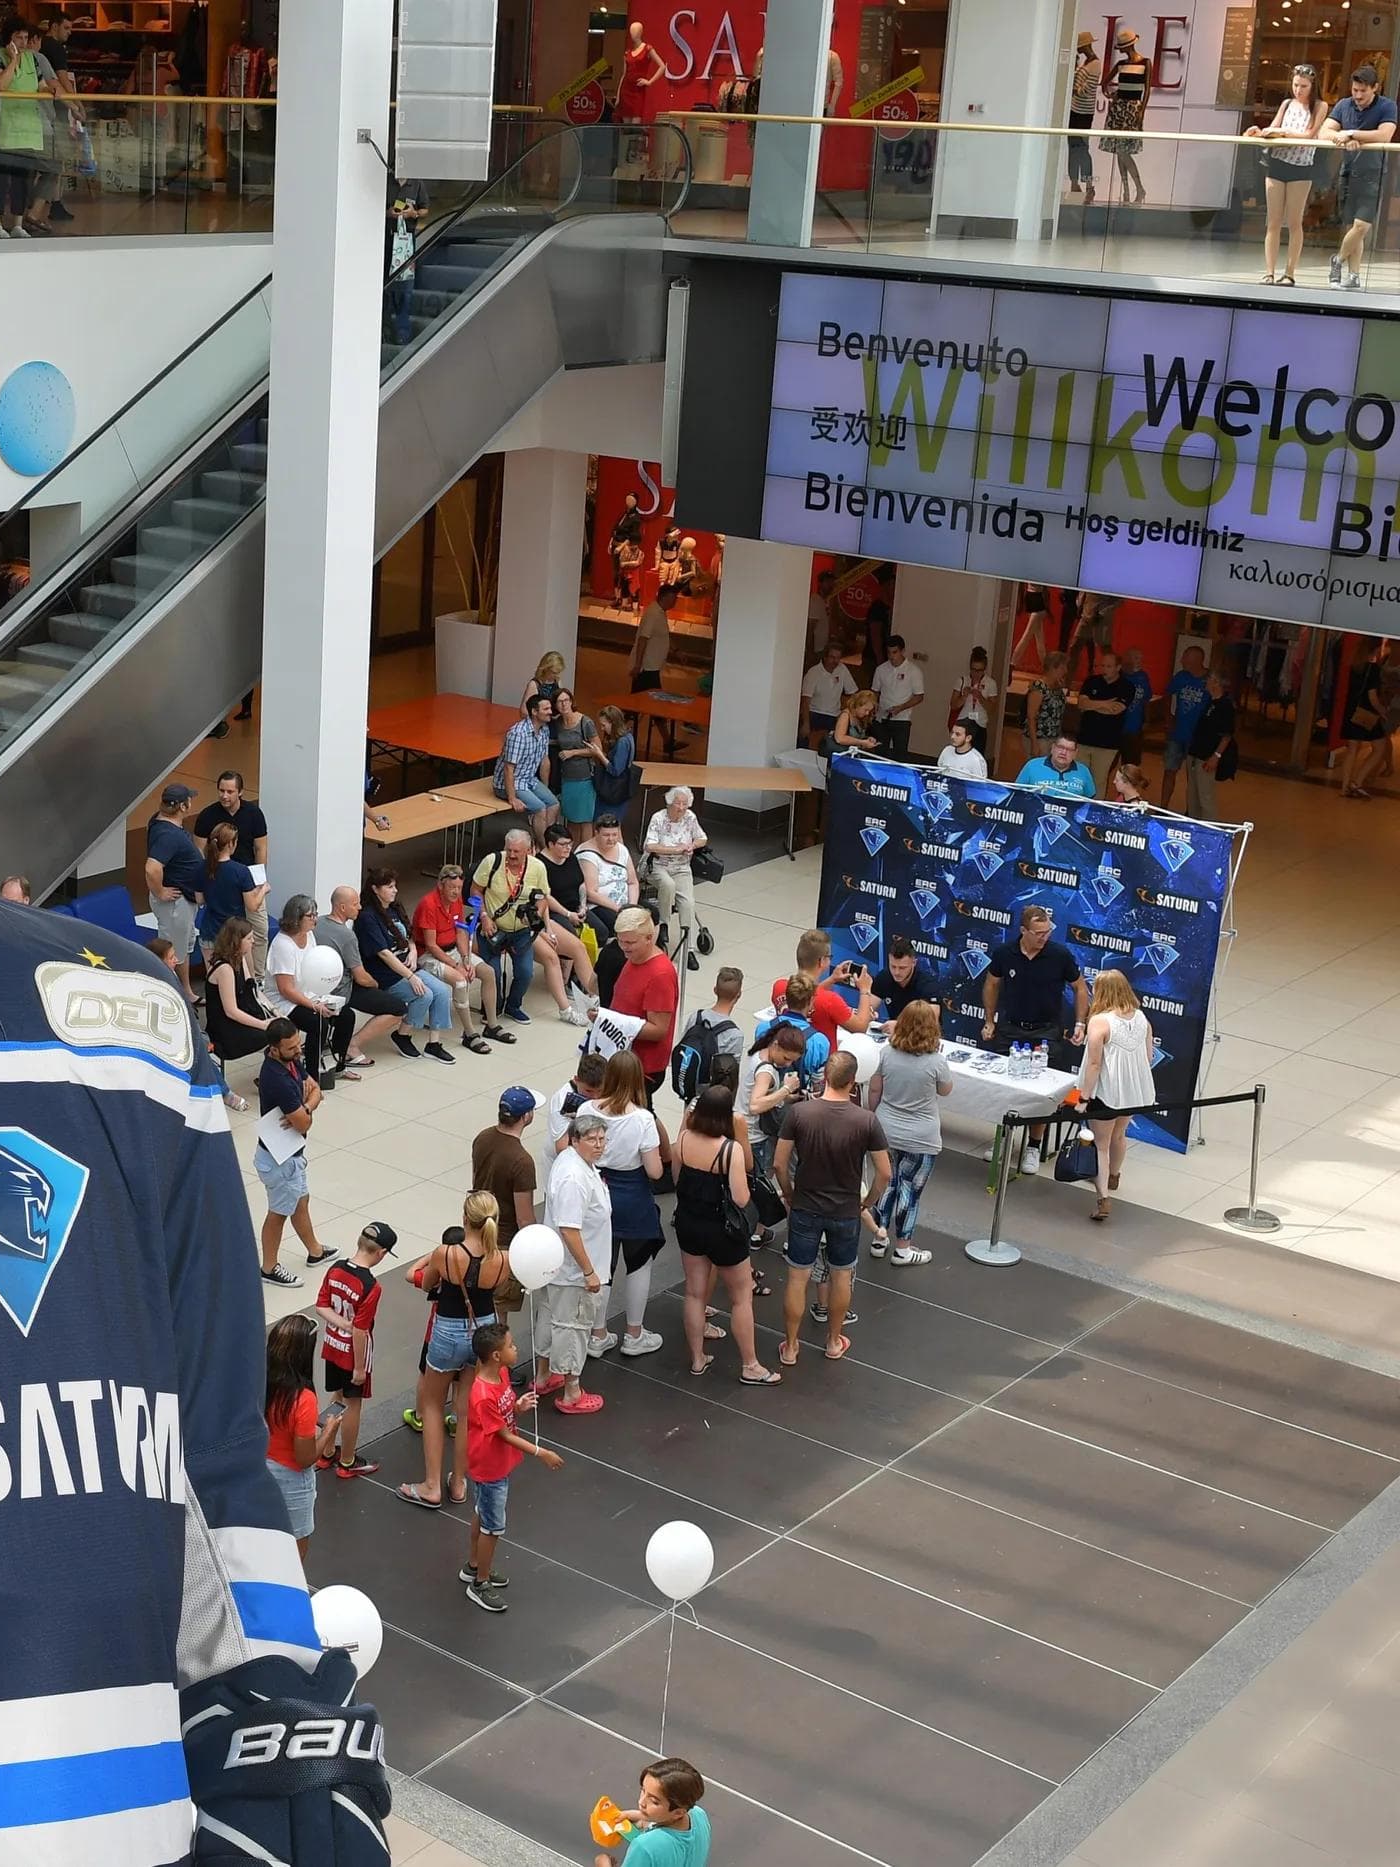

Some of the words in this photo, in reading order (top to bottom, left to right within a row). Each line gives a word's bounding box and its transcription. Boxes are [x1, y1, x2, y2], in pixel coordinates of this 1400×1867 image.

[664, 9, 766, 81] SA
[881, 105, 910, 120] 50%
[816, 320, 1030, 377] Benvenuto
[1143, 353, 1396, 452] Welco
[809, 406, 908, 452] 受欢迎
[804, 470, 1045, 543] Bienvenida
[1064, 505, 1120, 542] Hoş
[1127, 517, 1246, 553] geldiniz
[1330, 500, 1400, 563] Bi
[869, 783, 908, 802] SATURN
[926, 779, 949, 791] ERC
[984, 806, 1025, 826] SATURN
[1043, 803, 1068, 814] ERC
[864, 816, 887, 827] ERC
[1104, 829, 1147, 850] SATURN
[1166, 828, 1192, 840] ERC
[921, 842, 960, 861] SATURN
[978, 840, 1001, 850] ERC
[1036, 866, 1078, 887] SATURN
[1097, 865, 1122, 876] ERC
[859, 880, 897, 899] SATURN
[914, 878, 937, 890] ERC
[1156, 893, 1200, 914] SATURN
[854, 912, 876, 923] ERC
[972, 906, 1011, 925] SATURN
[966, 938, 989, 950] ERC
[1089, 932, 1132, 953] SATURN
[1151, 931, 1177, 943] ERC
[911, 940, 948, 959] SATURN
[1084, 966, 1101, 977] ER
[1141, 995, 1184, 1016] SATURN
[955, 1035, 978, 1047] ERC
[222, 1718, 386, 1771] Bau
